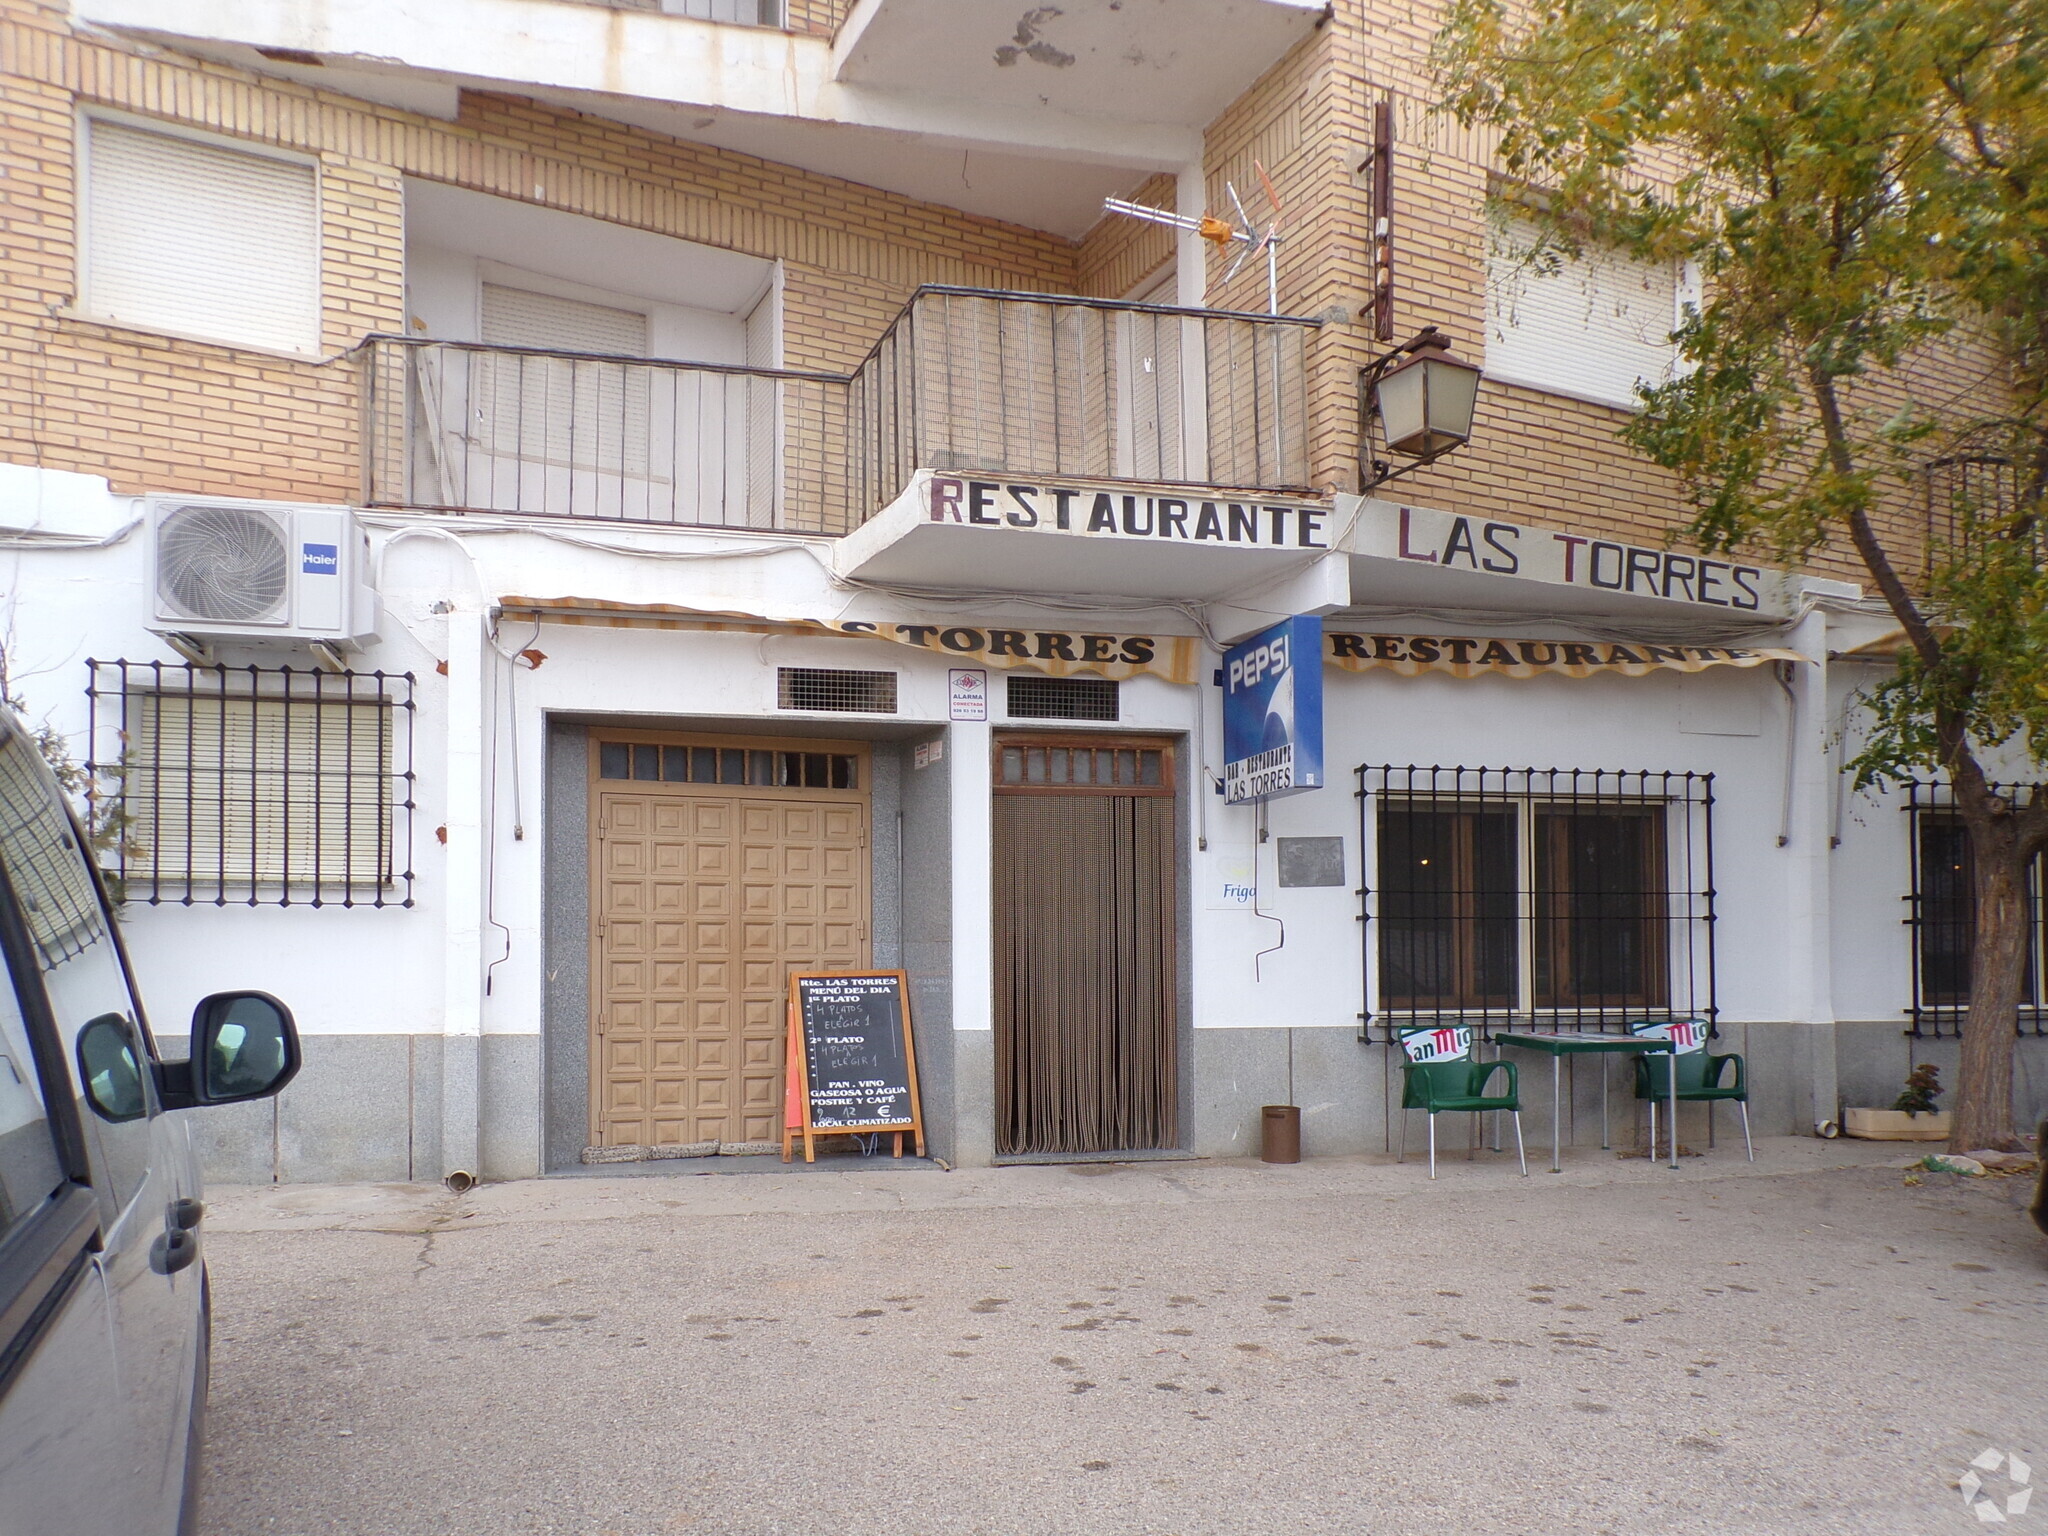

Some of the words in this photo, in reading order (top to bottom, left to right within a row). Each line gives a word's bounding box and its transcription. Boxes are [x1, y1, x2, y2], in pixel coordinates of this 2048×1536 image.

[930, 478, 1329, 548] RESTAURANTE
[303, 553, 337, 565] Haier
[1398, 507, 1520, 575] LAS
[1553, 533, 1760, 611] TORRES
[895, 624, 1156, 665] TORRES
[1328, 633, 1762, 666] RESTAURANTE
[1229, 634, 1290, 695] PEPSI
[1227, 762, 1239, 781] BAR
[1247, 745, 1291, 775] RESTAURANTE
[1227, 780, 1246, 803] LAS
[1250, 767, 1291, 797] TORRES
[1223, 884, 1256, 903] Frigo
[800, 979, 823, 987] Rte.
[851, 978, 898, 986] TORRES
[809, 986, 841, 995] MENÚ
[844, 986, 867, 994] DEL
[870, 986, 891, 994] DIA
[823, 995, 861, 1003] PLATO
[829, 1004, 863, 1015] PLATOS
[865, 1014, 870, 1026] 1
[826, 1036, 865, 1044] PLATO
[831, 1056, 868, 1068] ELEGIR
[871, 1054, 877, 1067] 1
[828, 1081, 850, 1089] PAN
[858, 1079, 885, 1088] VINO
[810, 1089, 863, 1097] GASEOSA
[865, 1088, 874, 1096] O
[876, 1086, 907, 1095] AGUA
[811, 1097, 854, 1106] POSTRE
[856, 1097, 864, 1105] Y
[866, 1095, 896, 1104] CAFÉ
[843, 1106, 856, 1119] 12
[877, 1105, 891, 1118] €
[812, 1120, 845, 1128] LOCAL
[846, 1117, 912, 1127] CLIMATIZADO
